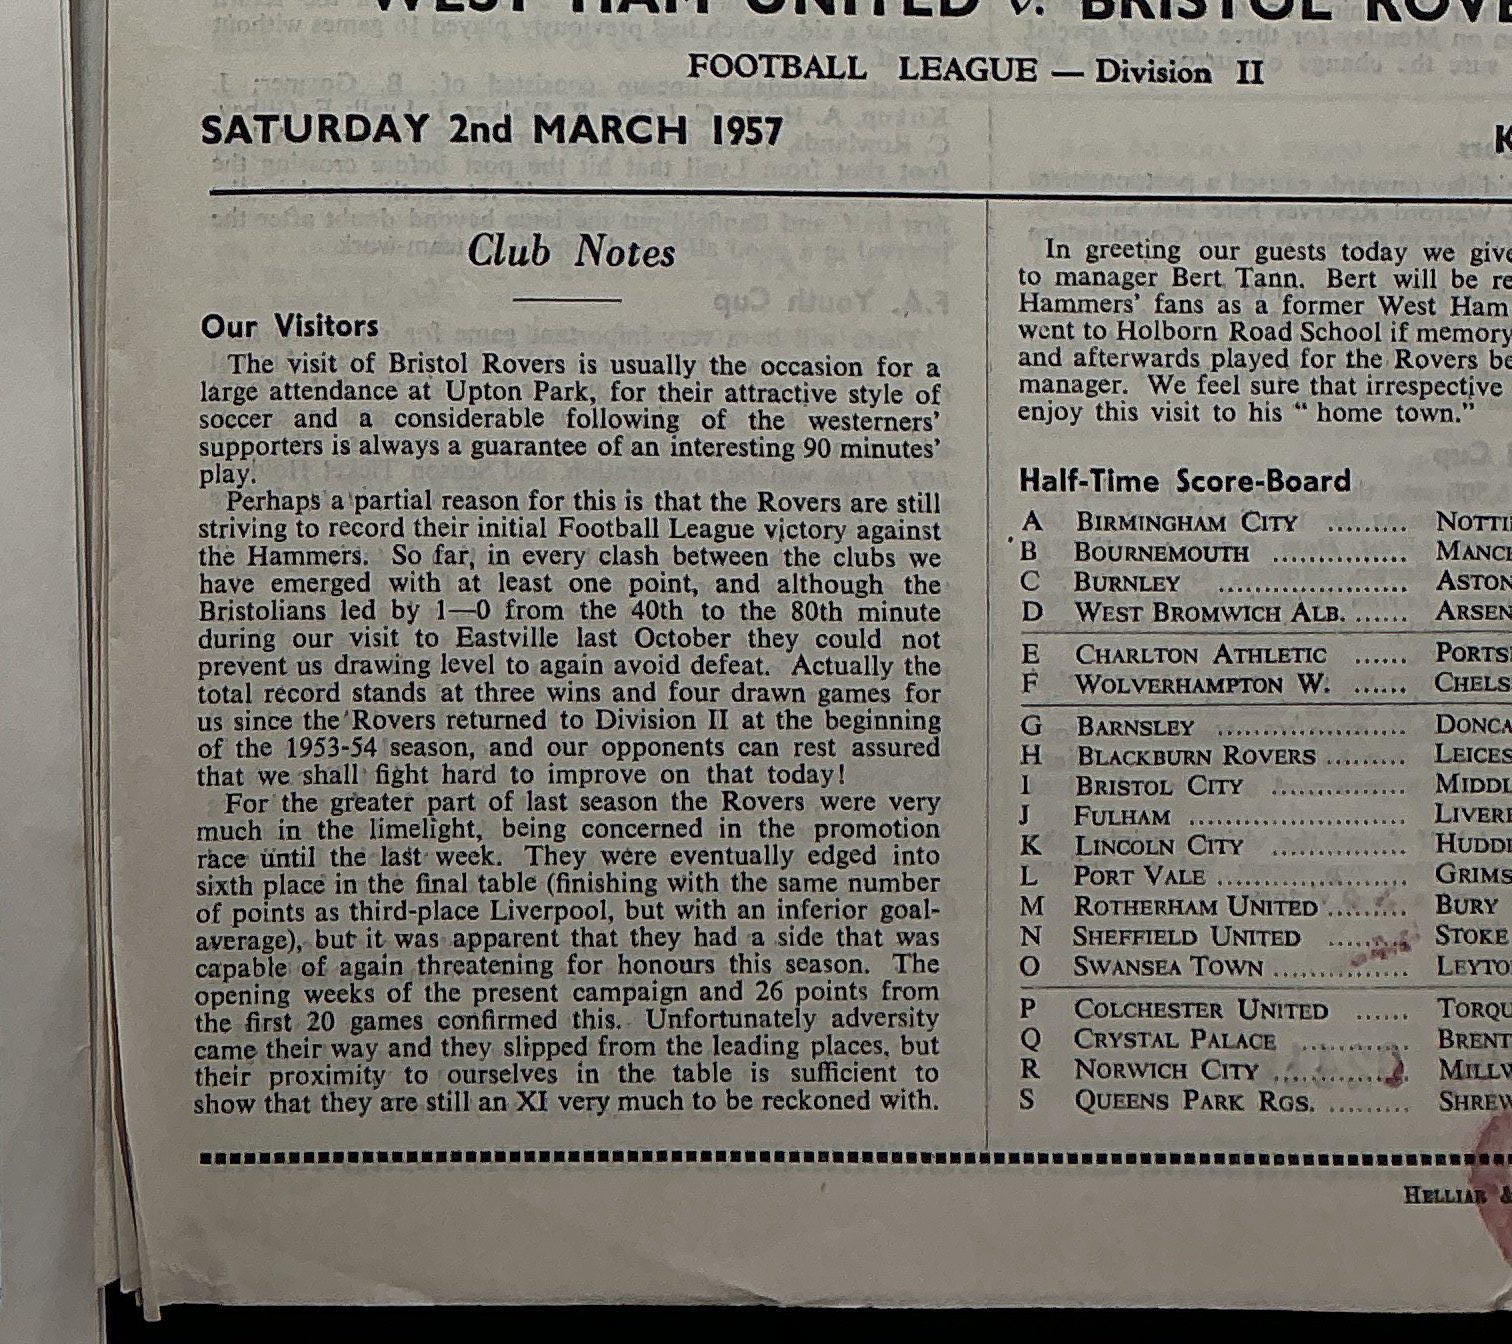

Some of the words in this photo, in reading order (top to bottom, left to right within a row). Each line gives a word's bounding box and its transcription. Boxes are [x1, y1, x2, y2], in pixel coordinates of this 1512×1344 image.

[200, 112, 431, 145] SATURDAY
[448, 112, 513, 144] 2nd
[533, 113, 687, 146] MARCH
[713, 114, 784, 147] 1957
[467, 231, 551, 268] Club
[573, 232, 676, 269] Notes
[1019, 466, 1160, 494] Half-Time
[1176, 467, 1351, 495] Score-Board
[1019, 925, 1043, 947] N
[1020, 997, 1036, 1019] P
[193, 1092, 257, 1115] show
[263, 1091, 312, 1115] that
[320, 1090, 373, 1118] they
[380, 1095, 419, 1113] are
[426, 1089, 470, 1113] still
[478, 1095, 508, 1113] an
[515, 1089, 549, 1112] XI
[557, 1094, 611, 1117] very
[617, 1088, 684, 1112] much
[692, 1090, 717, 1111] to
[725, 1087, 754, 1111] be
[761, 1088, 871, 1111] reckoned
[879, 1087, 939, 1111] with.
